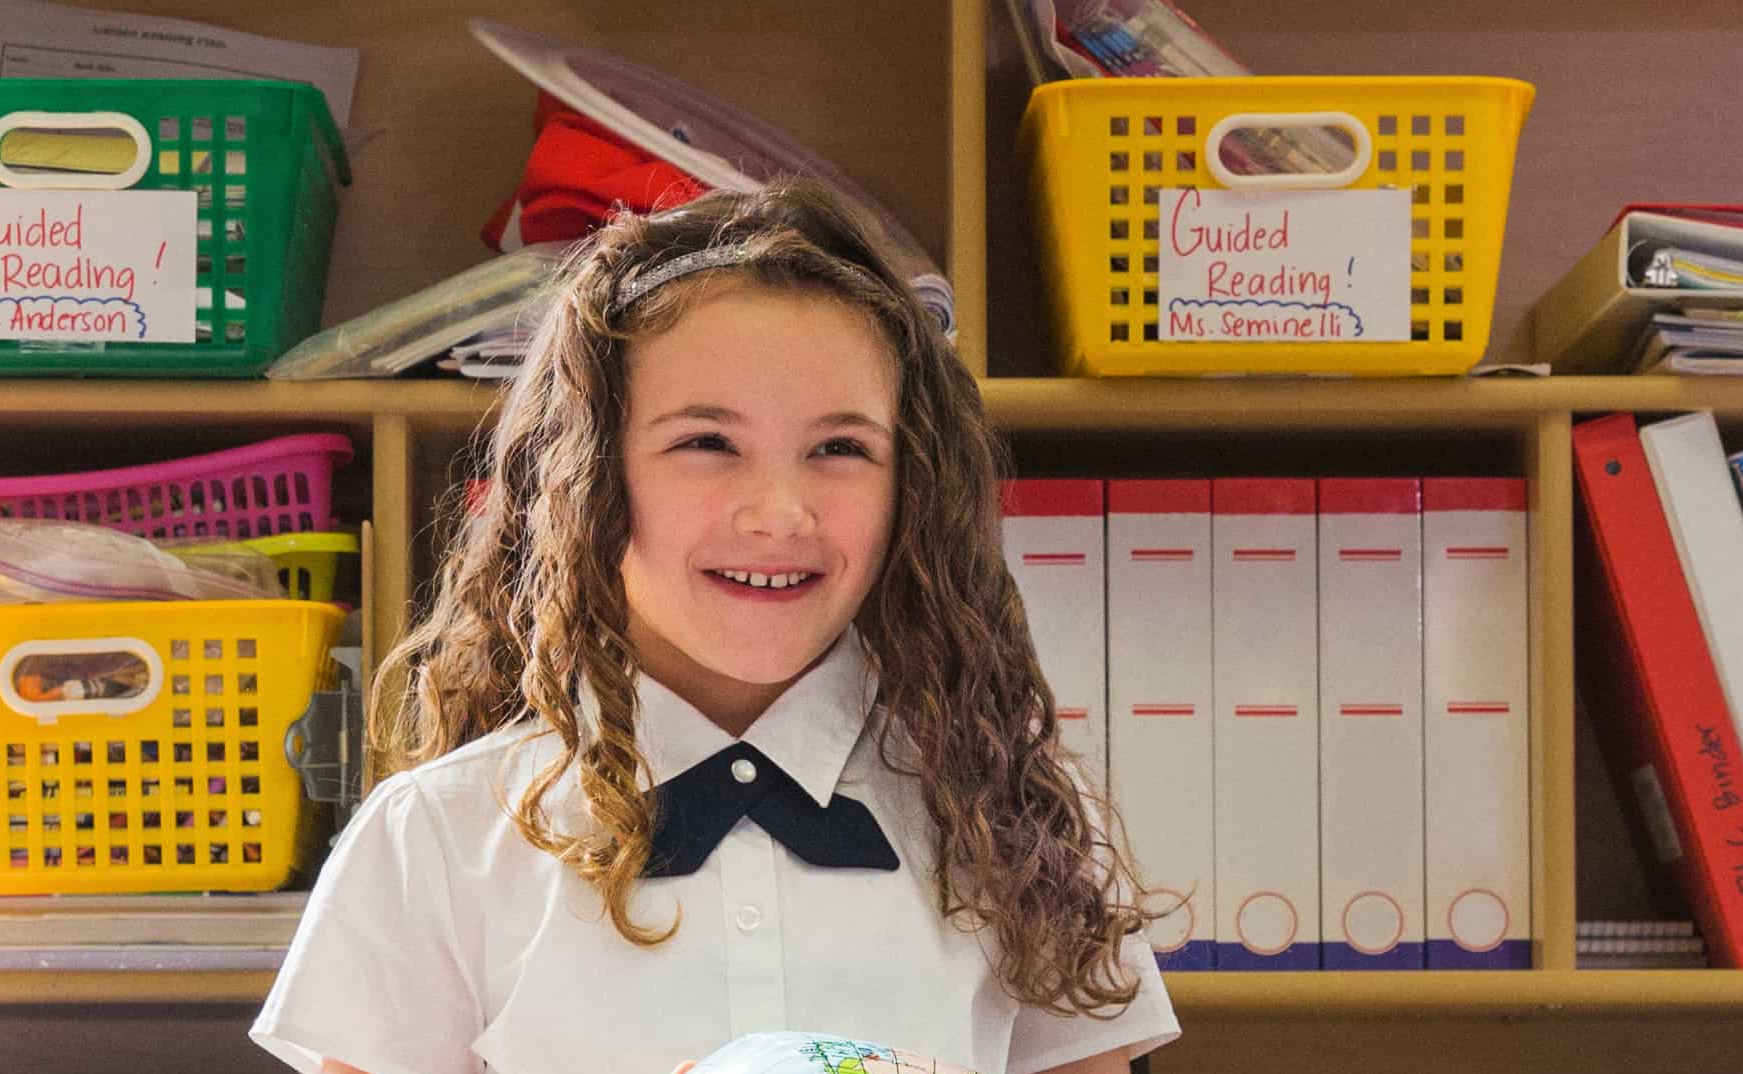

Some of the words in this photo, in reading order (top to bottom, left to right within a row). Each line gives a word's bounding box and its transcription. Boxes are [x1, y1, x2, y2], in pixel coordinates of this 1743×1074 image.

[1170, 188, 1289, 257] Guided
[0, 253, 135, 300] Reading
[1208, 262, 1331, 305] Reading
[9, 299, 127, 333] Anderson
[1170, 312, 1214, 337] Ms.
[1221, 311, 1342, 338] Seminelli
[1696, 722, 1740, 812] Binder
